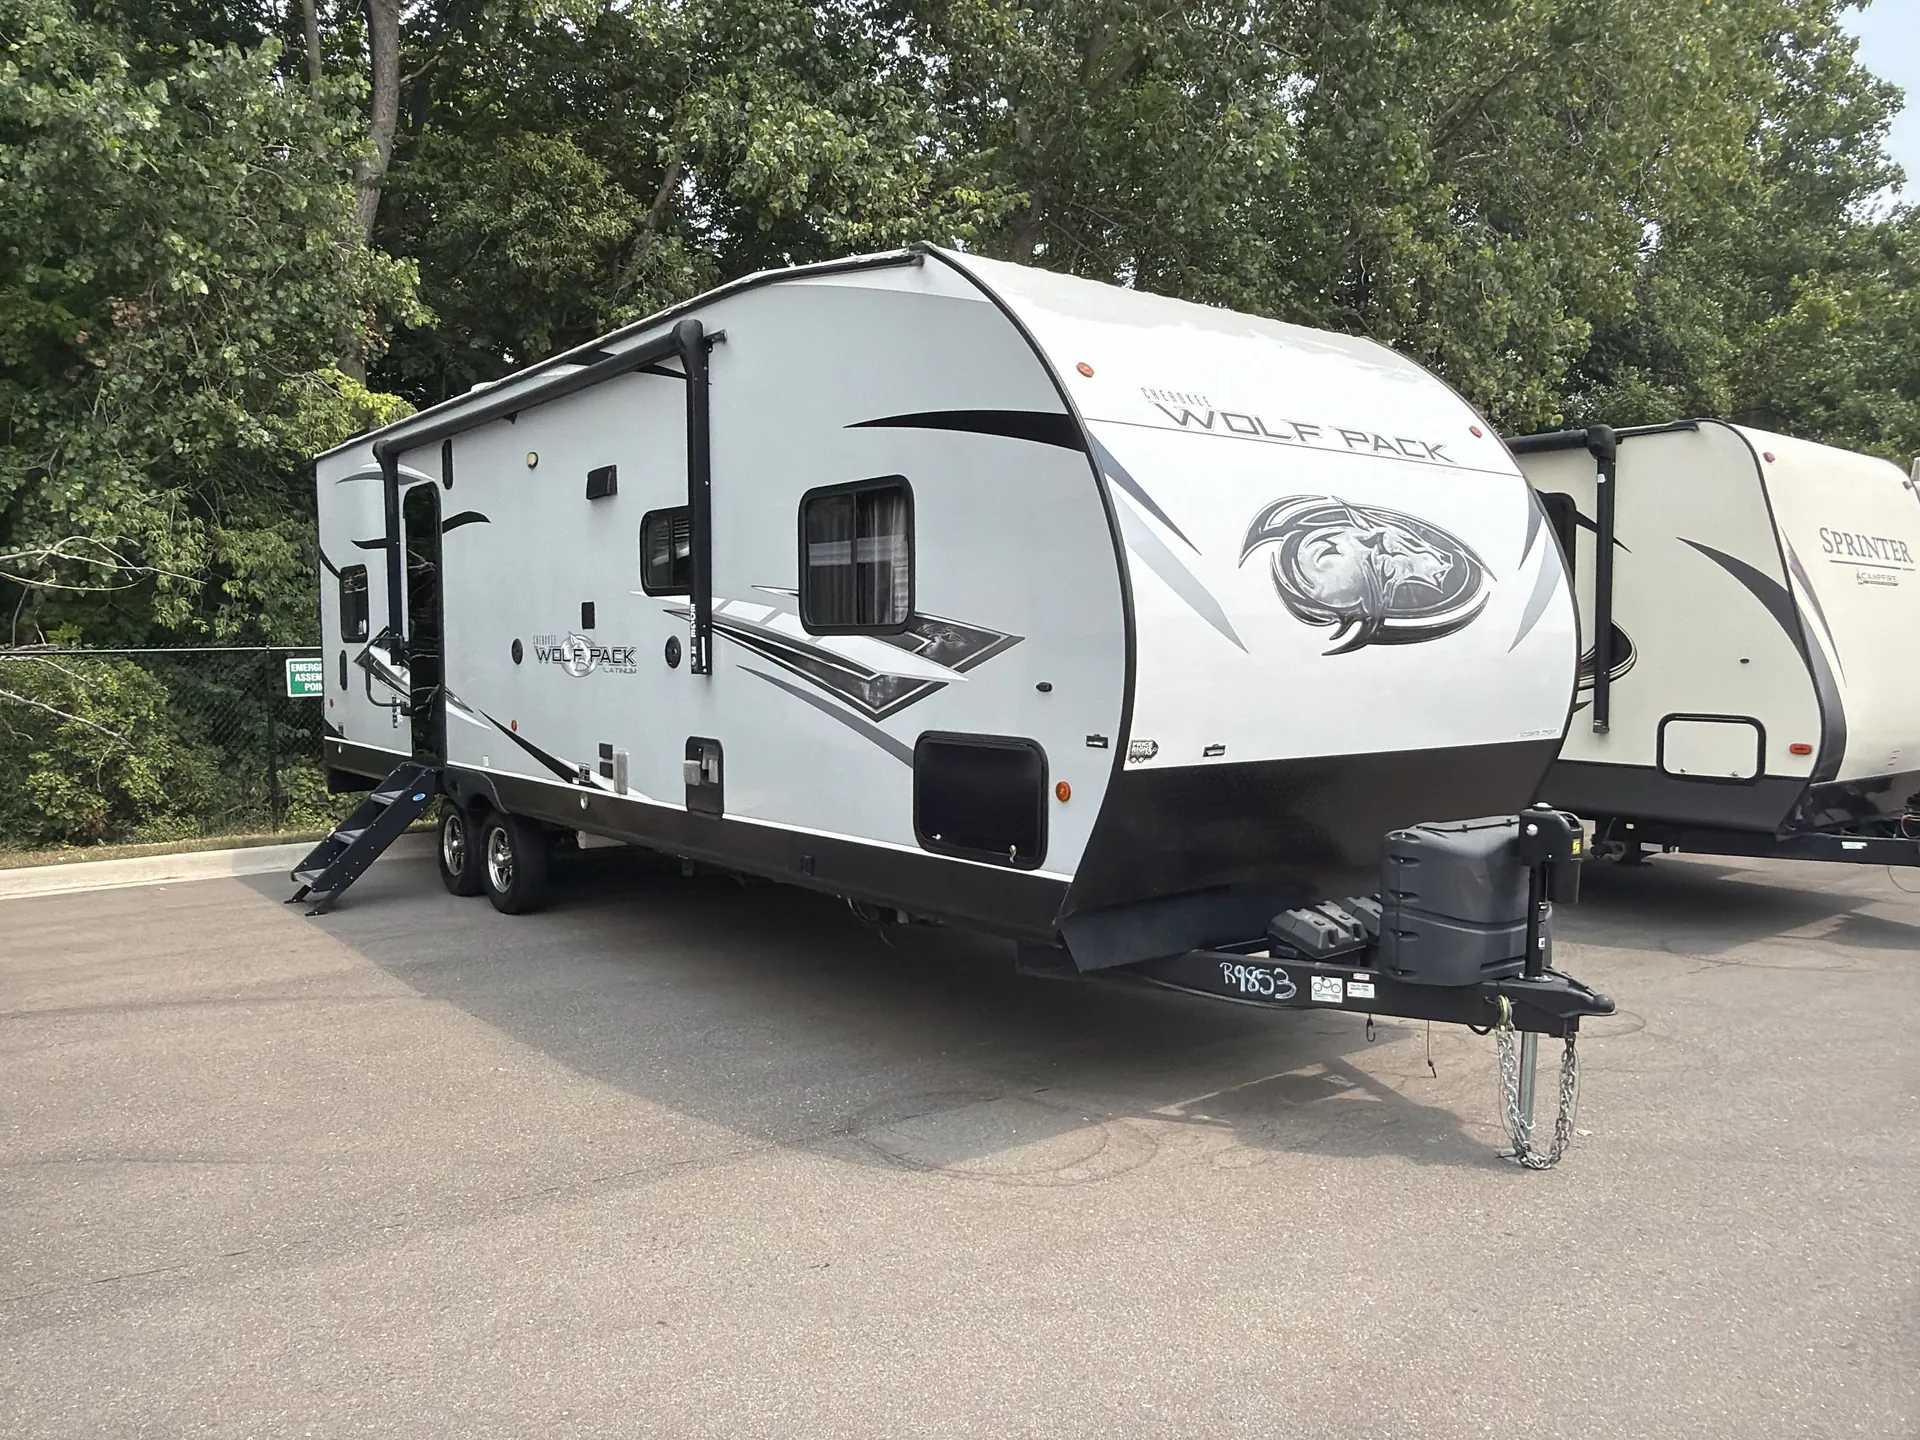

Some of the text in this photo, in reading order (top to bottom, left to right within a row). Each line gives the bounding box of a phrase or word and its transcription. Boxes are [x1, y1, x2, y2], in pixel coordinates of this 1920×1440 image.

[1140, 386, 1213, 408] CHEROKEE
[1150, 400, 1457, 464] WOLF PACK
[1819, 526, 1914, 564] SPRINTER
[535, 647, 637, 665] WOLF PACK
[294, 673, 323, 682] ASSEM
[304, 683, 323, 691] POIN
[1219, 962, 1298, 1000] R9853
